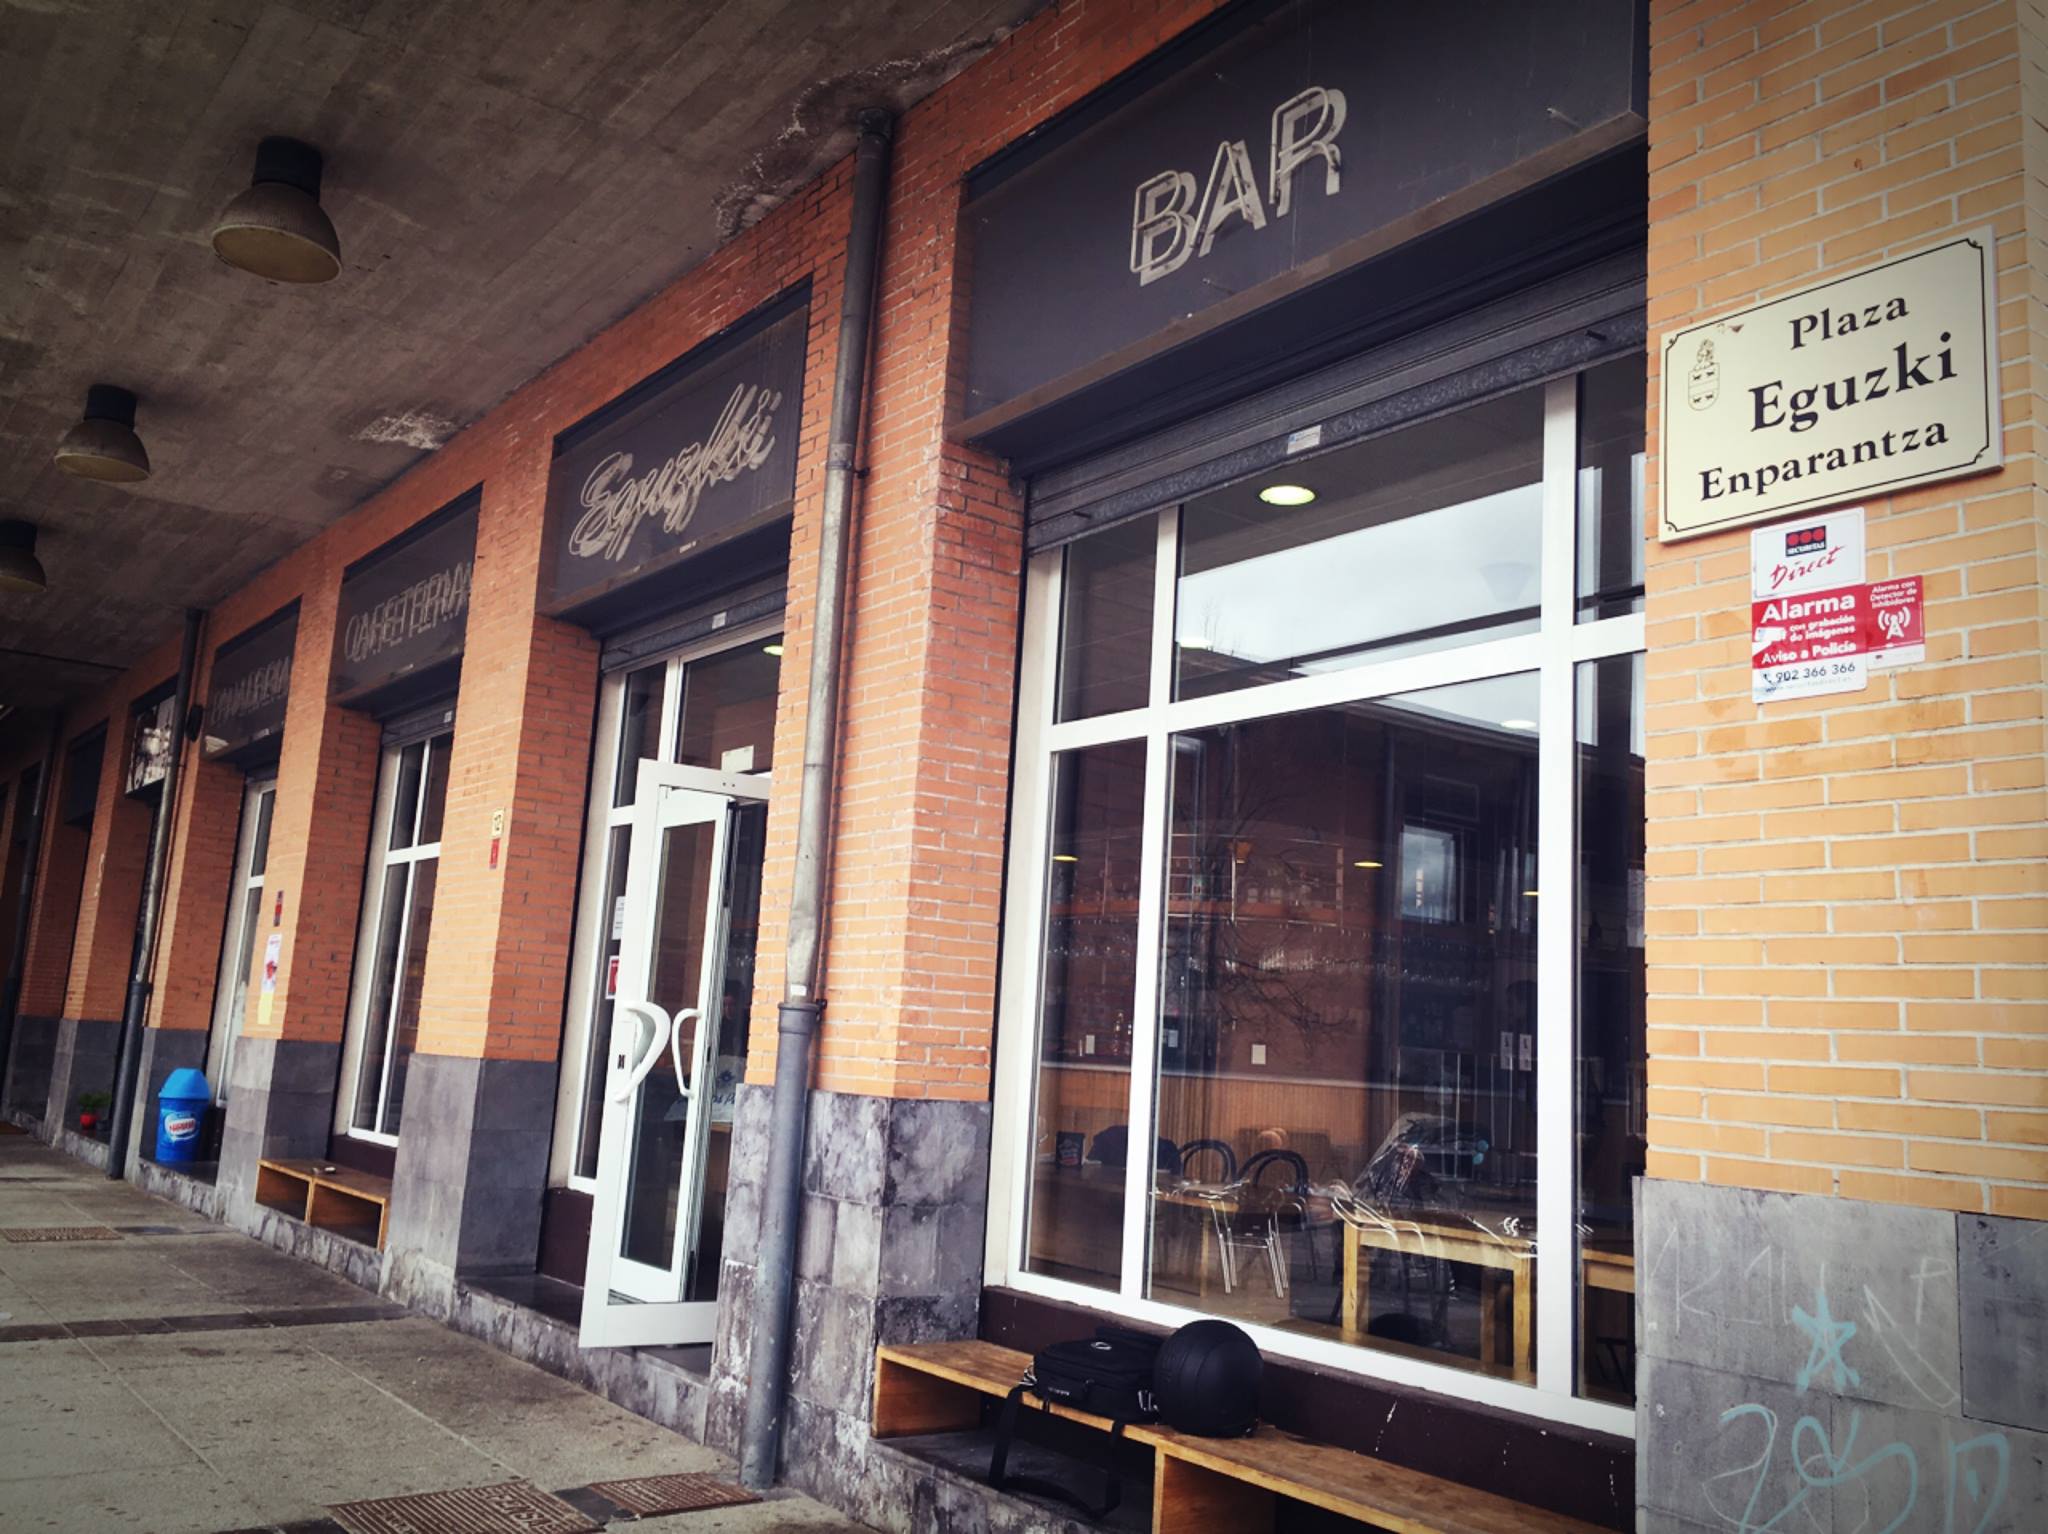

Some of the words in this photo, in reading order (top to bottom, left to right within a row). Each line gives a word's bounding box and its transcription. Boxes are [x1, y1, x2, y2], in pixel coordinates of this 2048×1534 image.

[1130, 86, 1347, 286] BAR
[1789, 296, 1910, 350] Plaza
[1748, 331, 1958, 433] Eguzki
[569, 382, 783, 562] Eguzki
[1699, 421, 1950, 502] Enparantza
[1770, 545, 1846, 590] Direct
[344, 562, 472, 663] CAFETERIA
[1760, 594, 1856, 624] Alarma
[1789, 623, 1806, 633] con
[1807, 614, 1856, 631] grabación
[1789, 632, 1803, 642] de
[1804, 625, 1856, 640] imágenes
[1761, 650, 1798, 665] Aviso
[1800, 649, 1809, 659] a
[1812, 640, 1857, 657] Policía
[1775, 669, 1799, 684] 902
[1803, 666, 1827, 678] 366
[1831, 662, 1855, 675] 366
